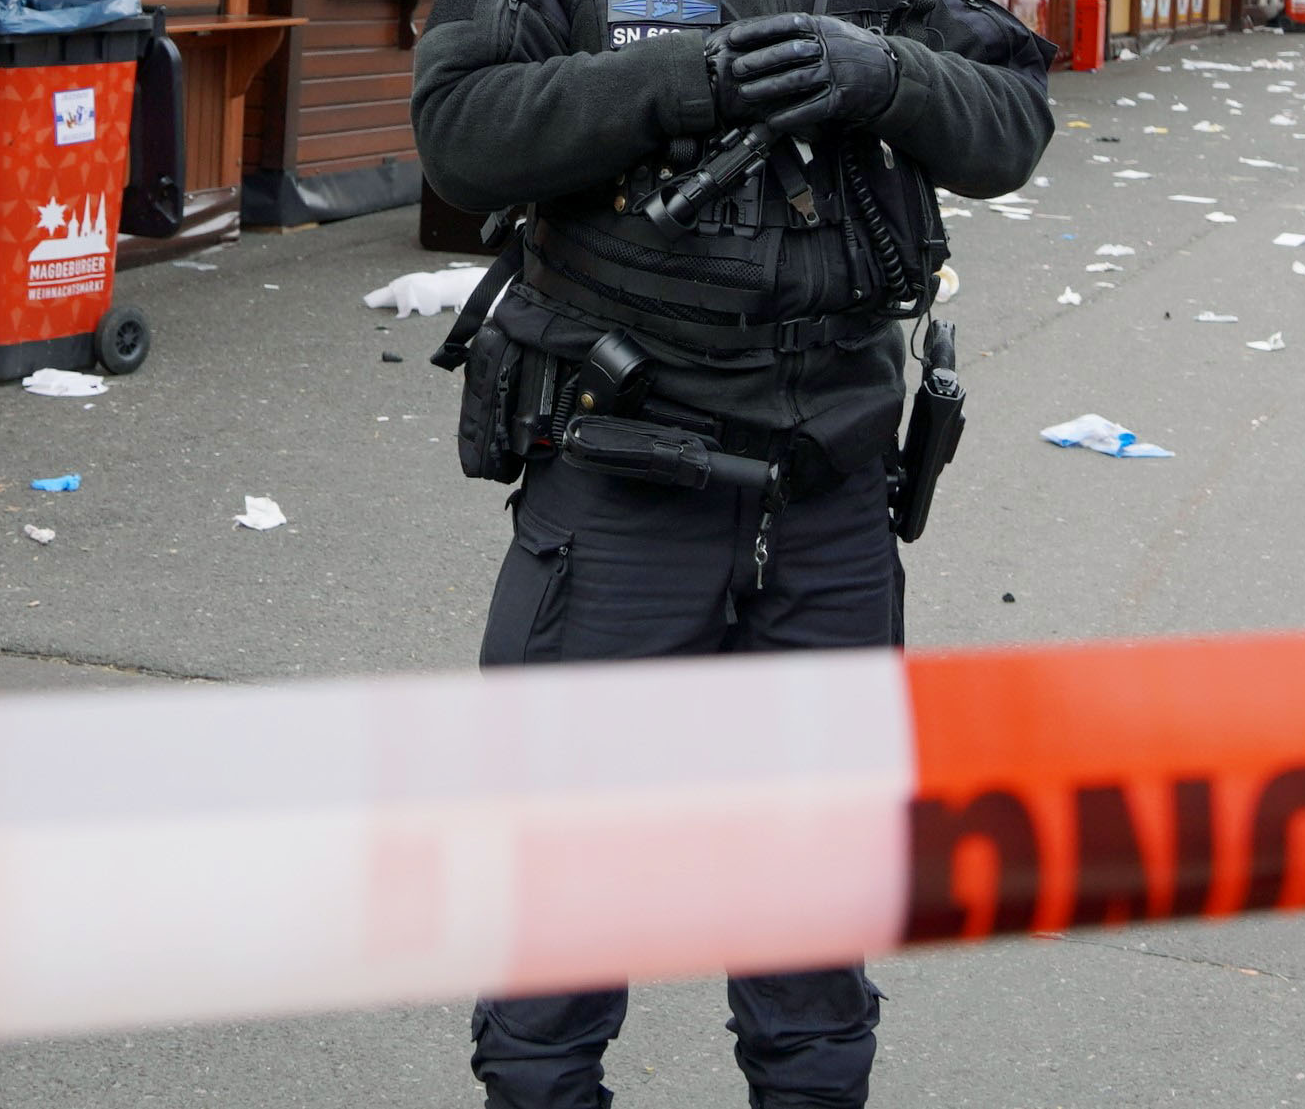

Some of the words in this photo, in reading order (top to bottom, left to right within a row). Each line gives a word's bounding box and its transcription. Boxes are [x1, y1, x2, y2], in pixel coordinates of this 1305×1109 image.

[613, 27, 641, 44] SN
[29, 256, 106, 280] MAGDEBURGER
[28, 280, 105, 300] WEIHNACHTSMARKT
